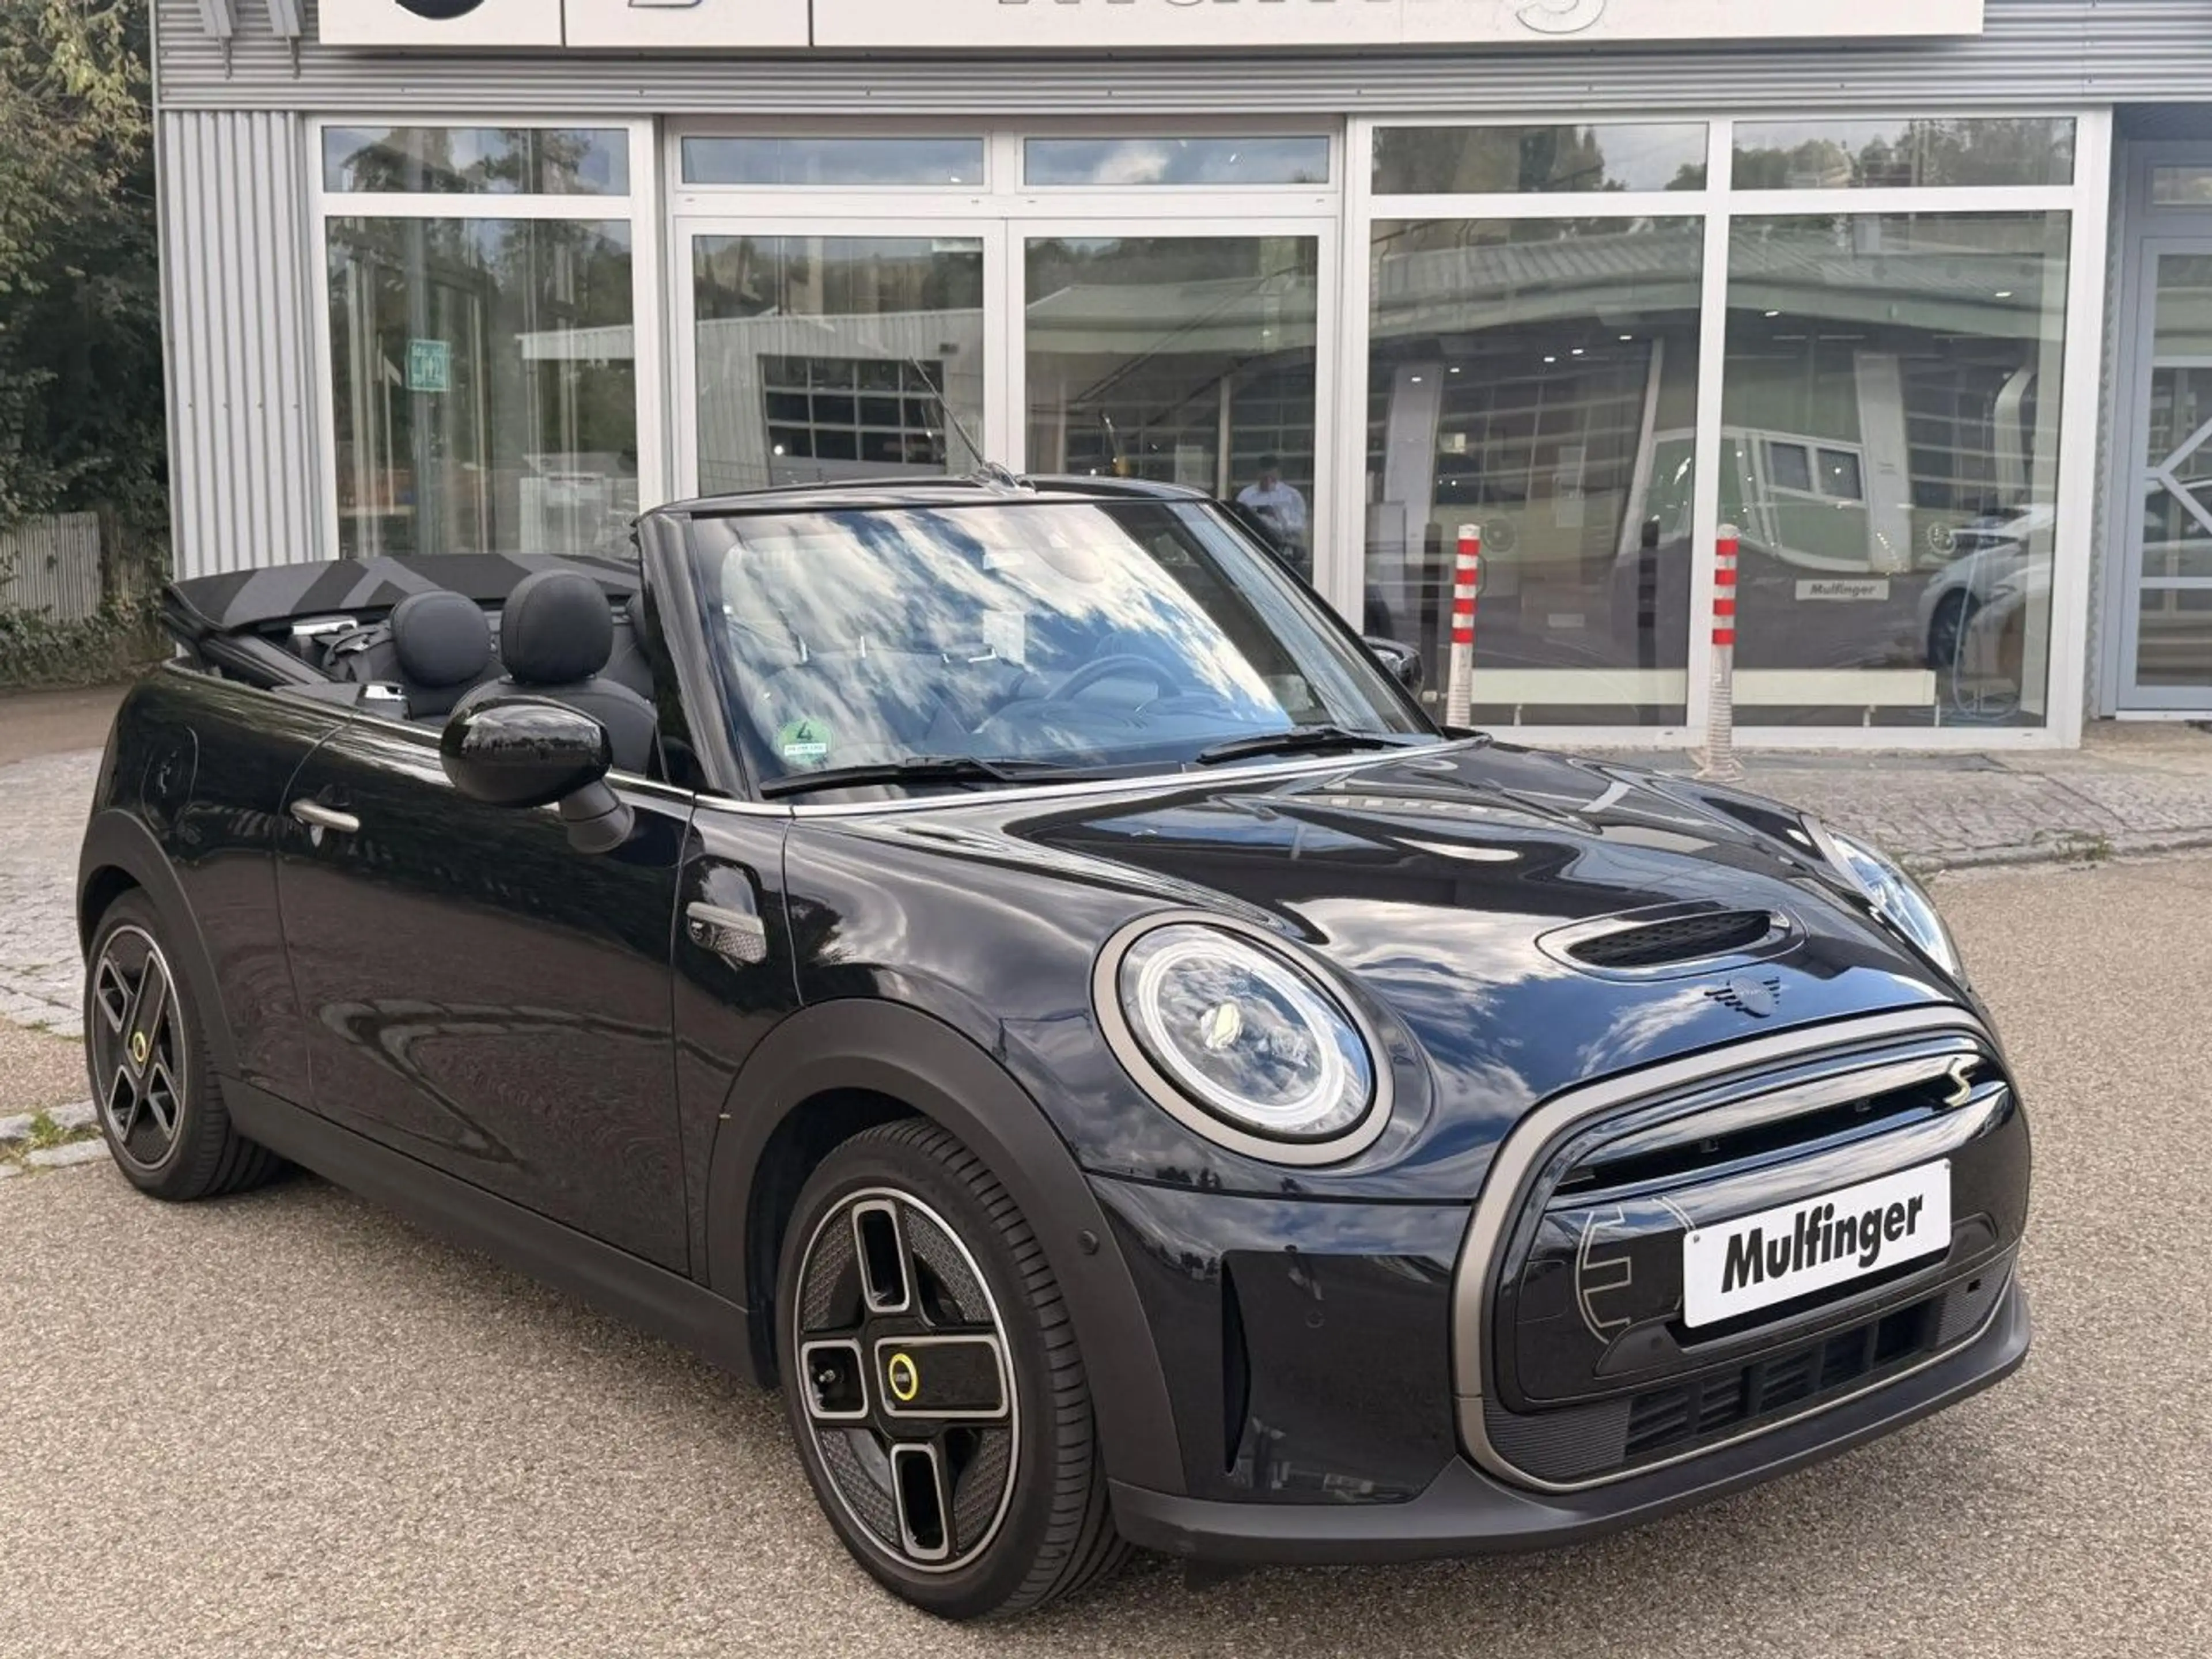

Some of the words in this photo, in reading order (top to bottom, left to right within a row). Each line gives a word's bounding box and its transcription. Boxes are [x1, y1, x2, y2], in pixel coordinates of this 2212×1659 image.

[1810, 582, 1877, 597] Mulfinger
[797, 721, 813, 741] 4
[1943, 1054, 1980, 1108] S
[1721, 1194, 1923, 1294] Mulfinger
